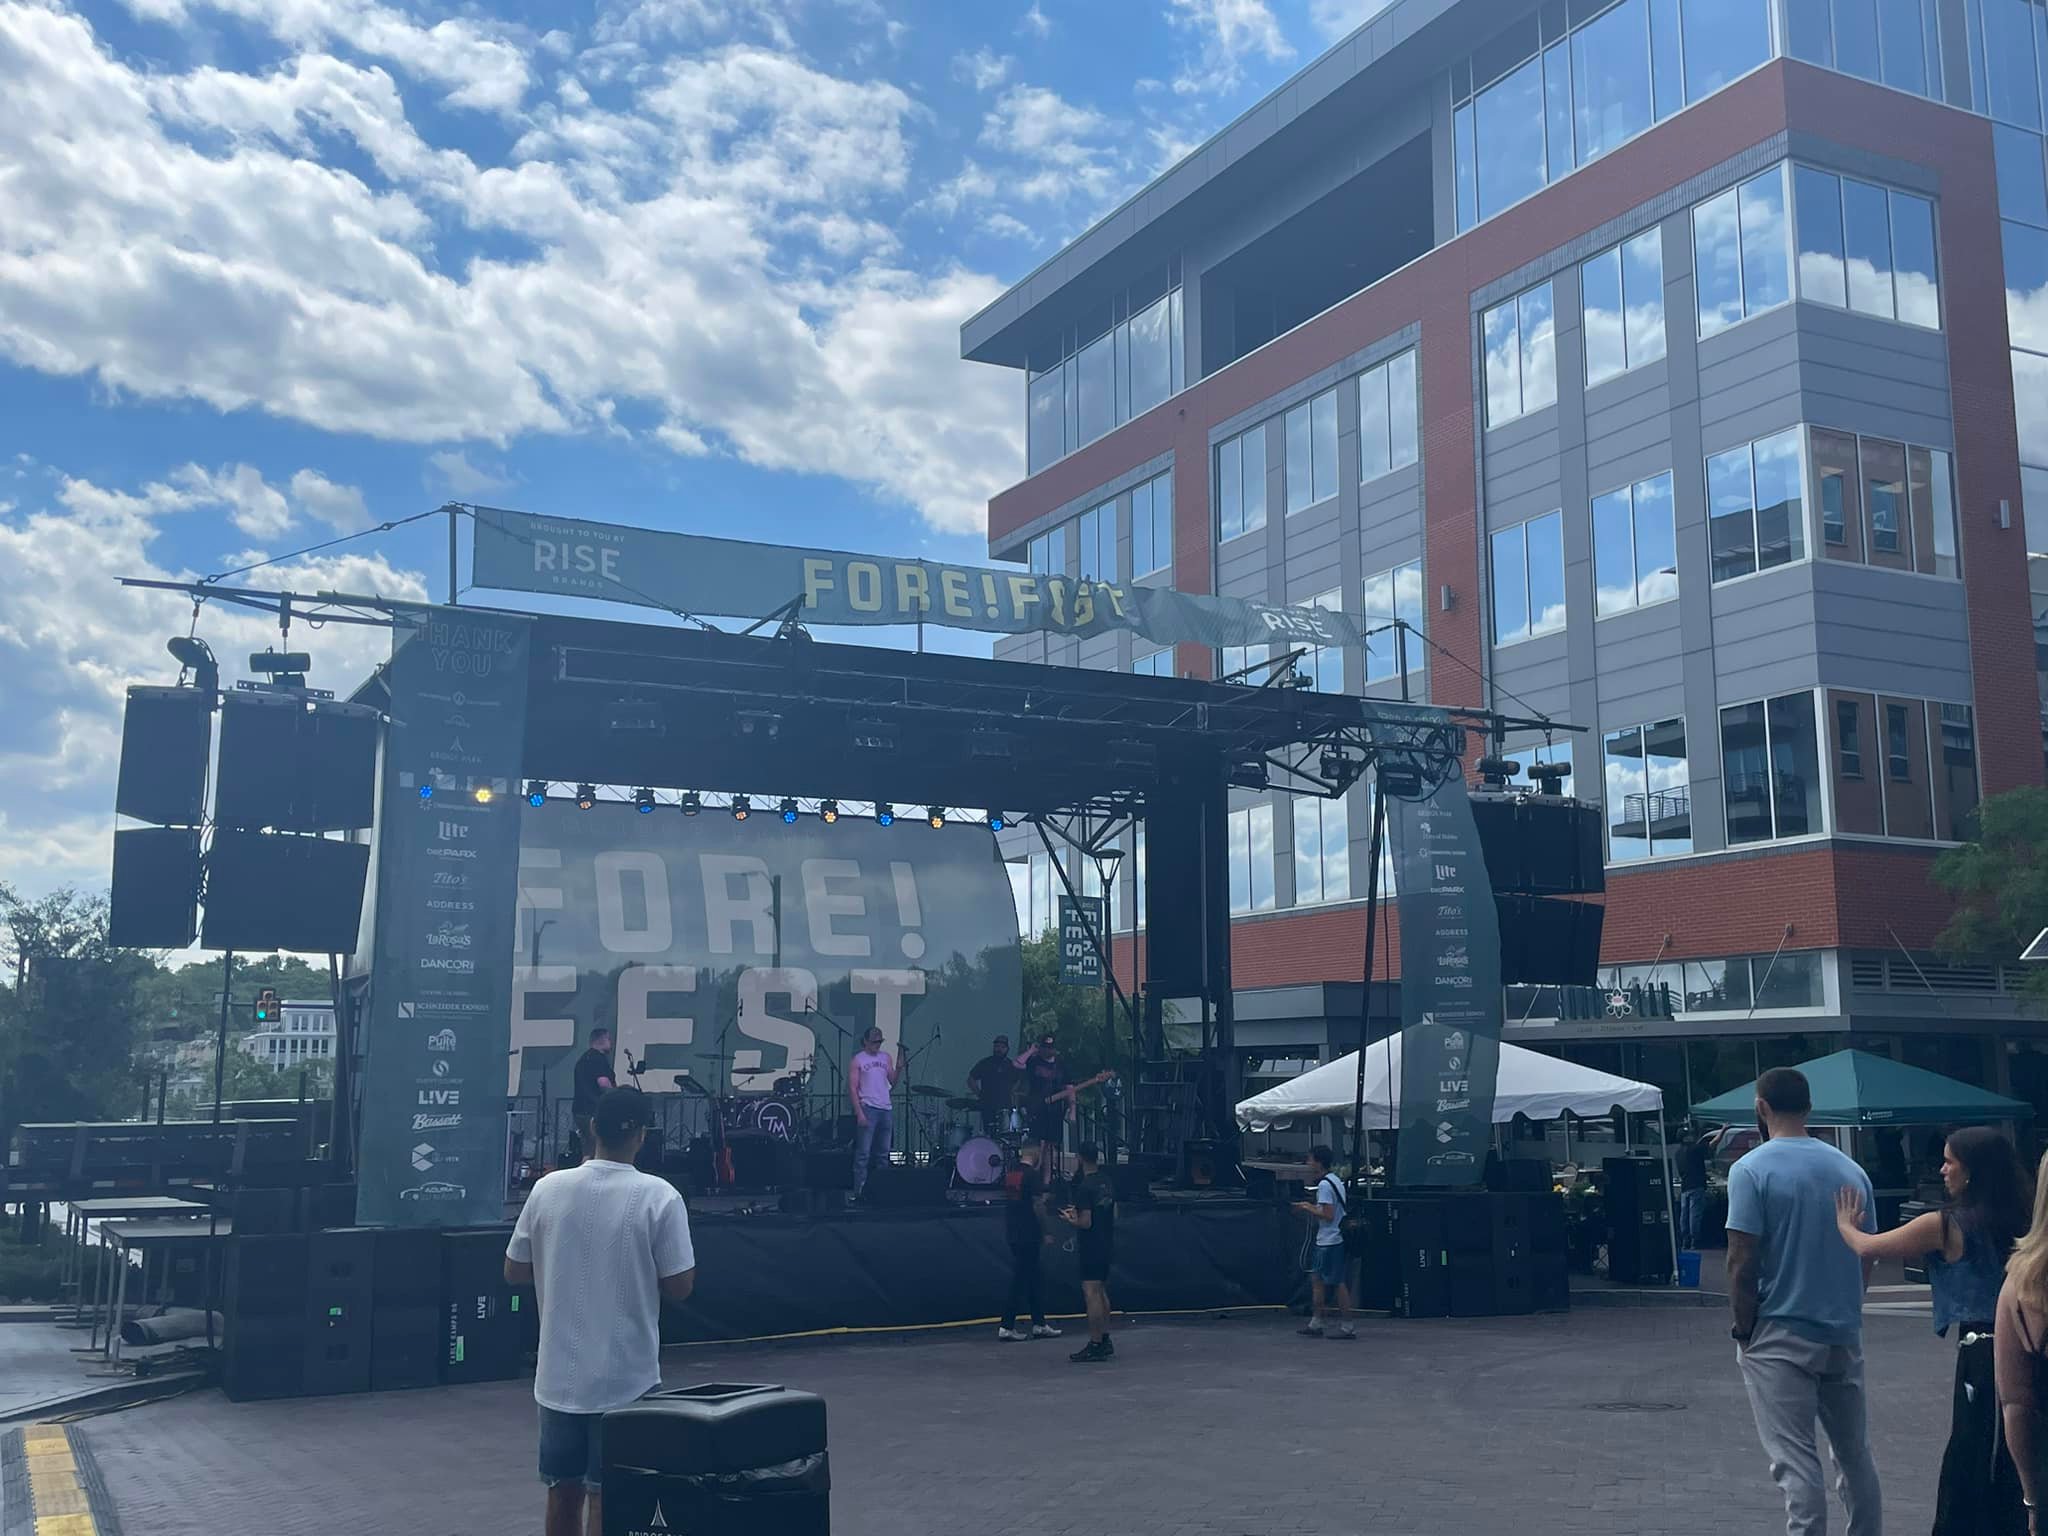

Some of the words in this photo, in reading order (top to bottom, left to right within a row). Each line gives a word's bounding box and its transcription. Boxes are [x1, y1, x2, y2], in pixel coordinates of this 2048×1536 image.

[534, 538, 621, 582] RISE
[1261, 612, 1333, 639] RISE
[432, 647, 492, 677] YOU
[438, 820, 470, 840] Lite
[1435, 864, 1456, 880] Lite
[426, 899, 475, 911] ADDRESS
[514, 848, 926, 959] FORE!
[506, 965, 926, 1098] FEST
[412, 1113, 463, 1130] Bassett
[477, 1296, 487, 1319] LIVE
